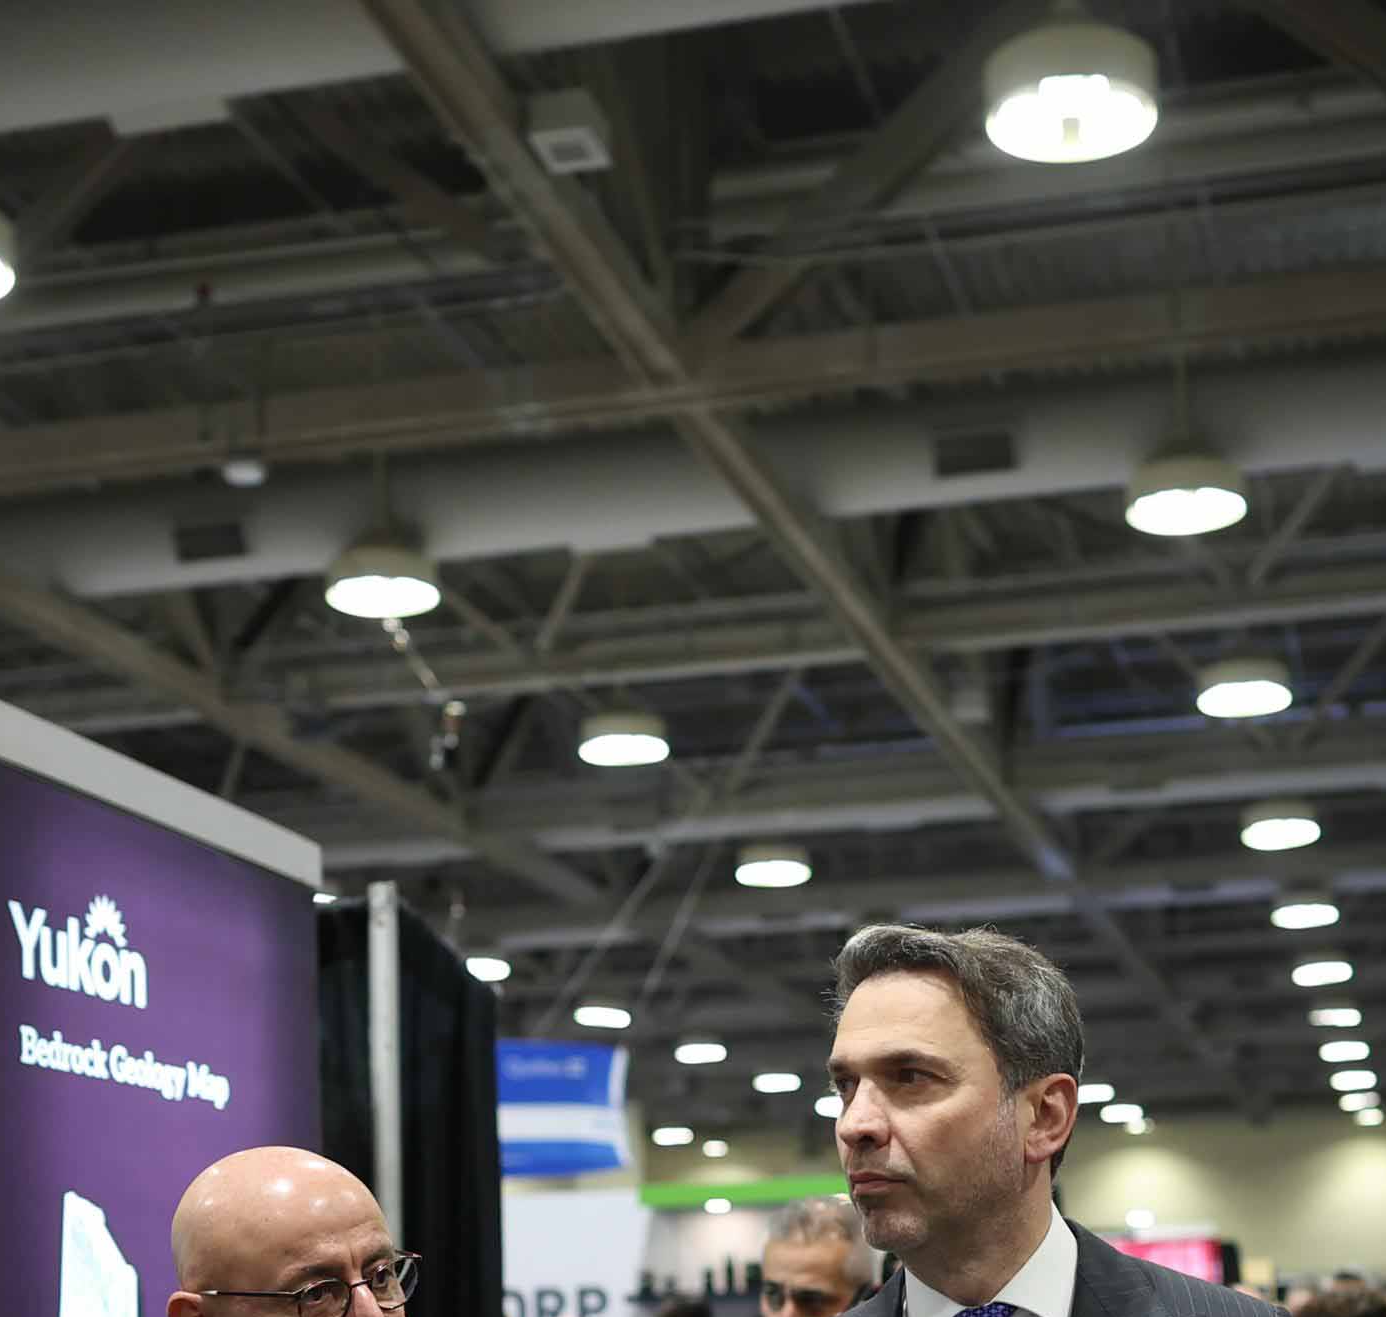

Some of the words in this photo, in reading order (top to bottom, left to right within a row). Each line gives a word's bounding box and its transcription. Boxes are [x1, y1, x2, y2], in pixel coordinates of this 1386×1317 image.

[8, 899, 148, 1009] Yukon
[19, 1023, 110, 1080] Bedrock
[109, 1044, 187, 1101] Geology
[186, 1060, 230, 1110] Map
